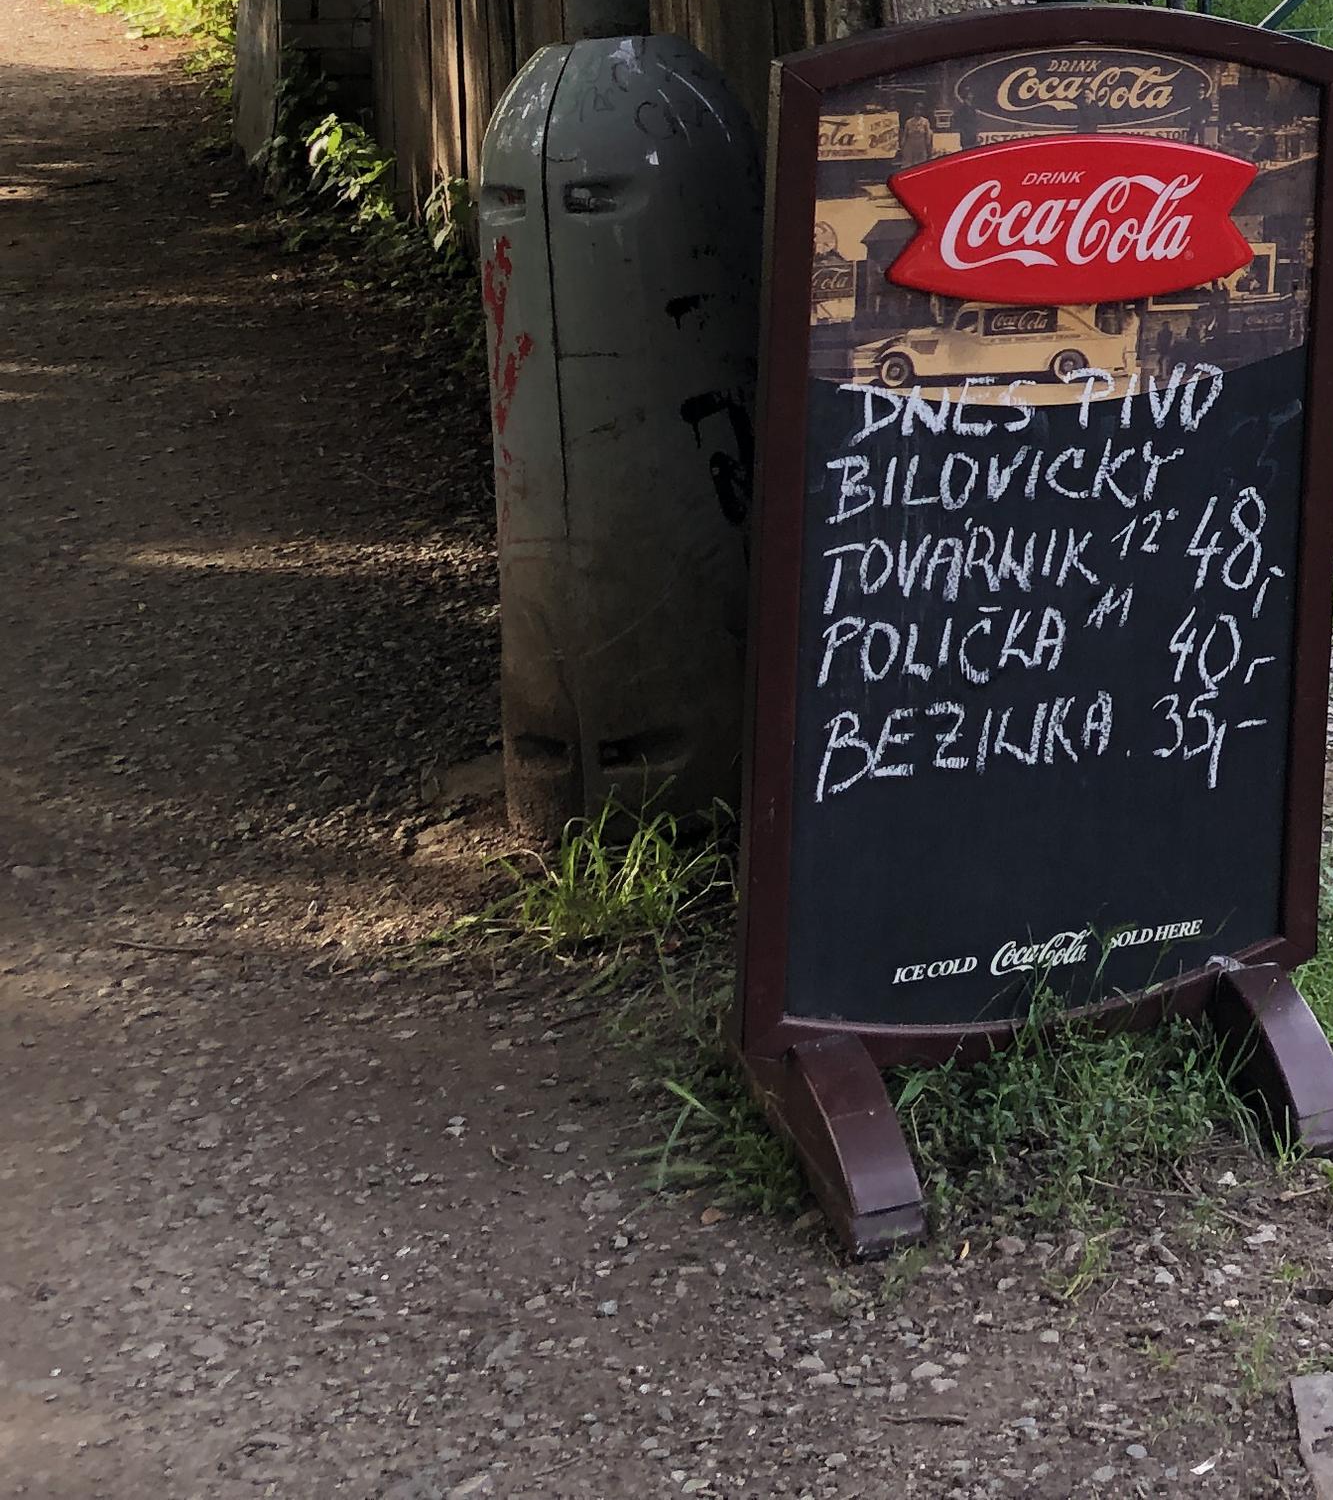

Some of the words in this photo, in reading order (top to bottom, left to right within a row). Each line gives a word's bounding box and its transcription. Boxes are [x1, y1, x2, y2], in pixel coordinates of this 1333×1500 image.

[997, 66, 1183, 112] Coca-Cola
[1047, 59, 1101, 73] DRINK
[1021, 171, 1085, 186] DRINK
[940, 173, 1203, 270] Coca-Cola
[836, 376, 1036, 447] DNES
[1064, 362, 1223, 432] PIVO
[826, 438, 1185, 524] BILOVICKY
[892, 964, 925, 984] ICE
[927, 956, 978, 979] COLD
[990, 928, 1094, 976] Coca-Cola
[1110, 928, 1154, 950] SOLD
[1154, 918, 1203, 942] HERE
